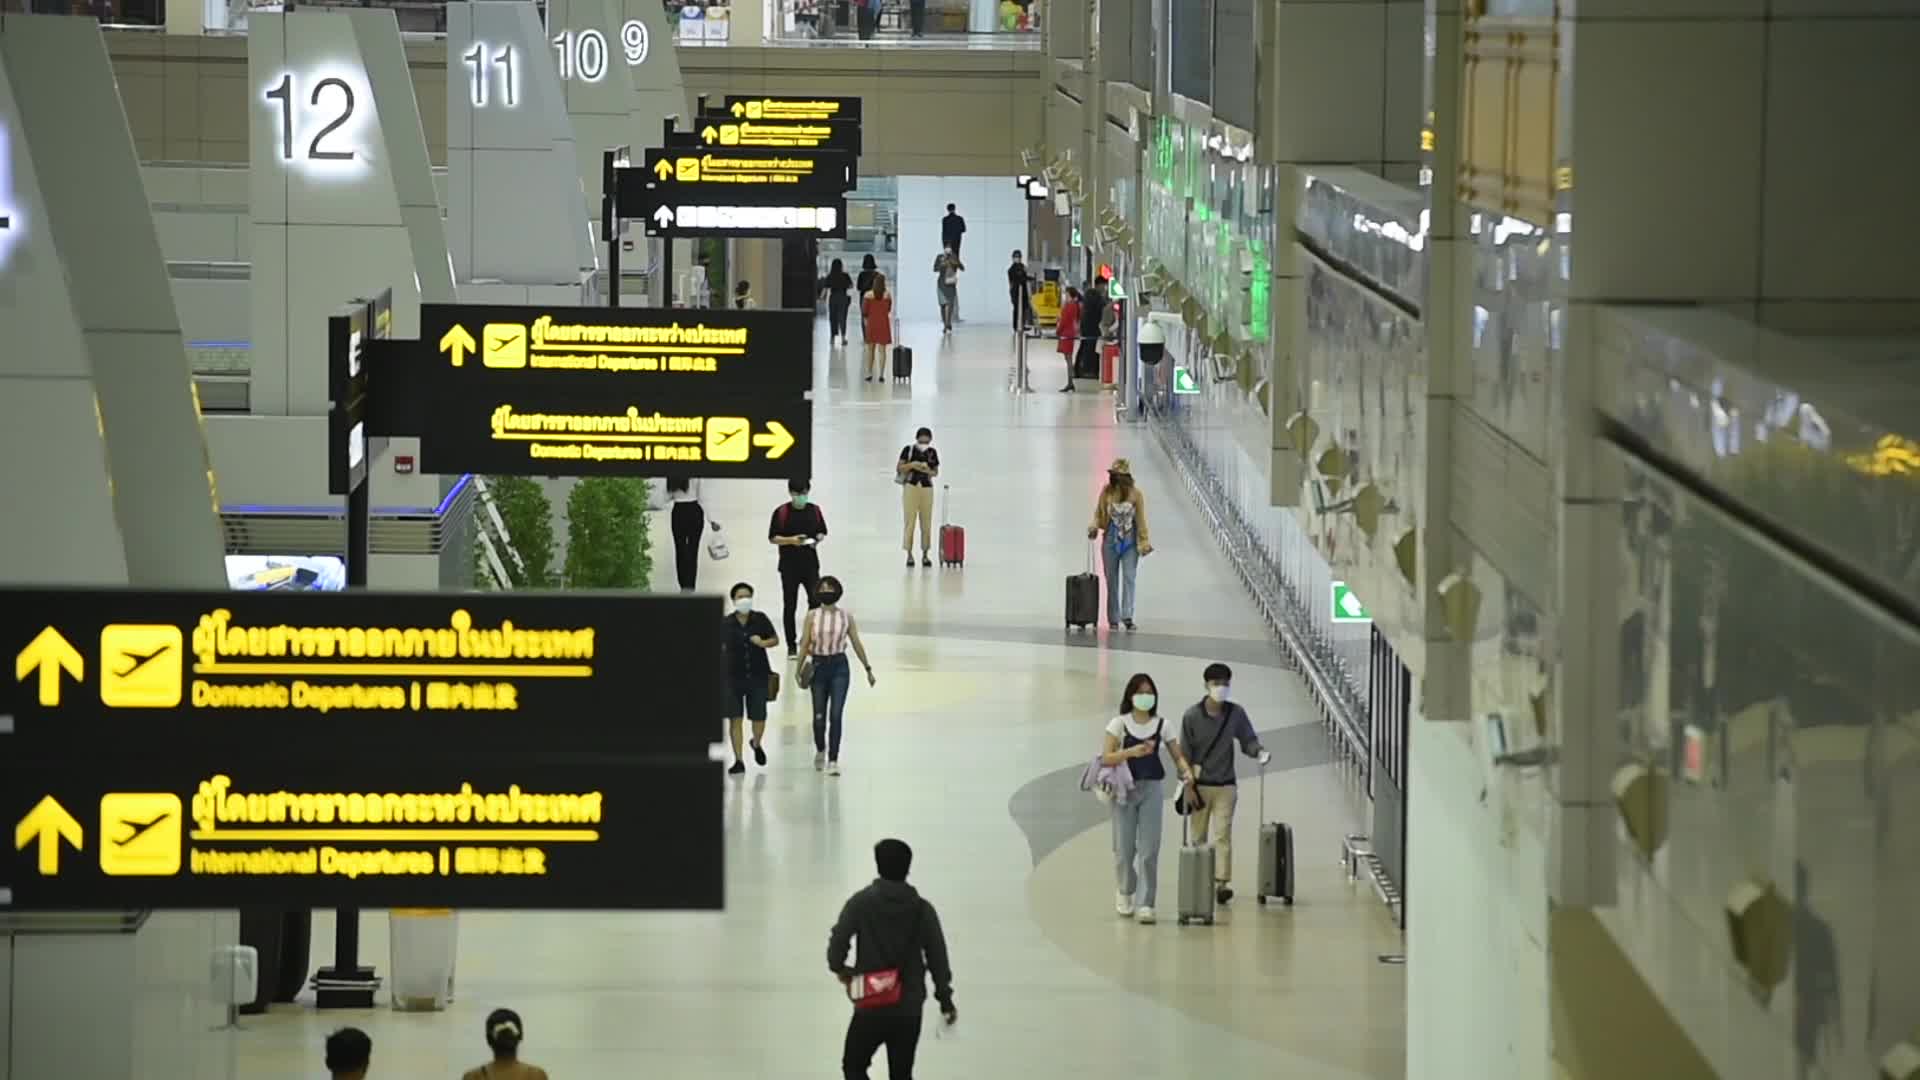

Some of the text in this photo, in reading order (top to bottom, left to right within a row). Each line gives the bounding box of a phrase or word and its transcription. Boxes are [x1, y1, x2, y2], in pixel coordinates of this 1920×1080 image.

[553, 30, 607, 81] 10
[621, 20, 649, 64] 9
[463, 42, 515, 106] 11
[266, 74, 355, 160] 12
[598, 354, 658, 371] Departures
[582, 443, 643, 461] Departures
[192, 681, 406, 712] Domestic Departures
[190, 847, 435, 879] International Departures
